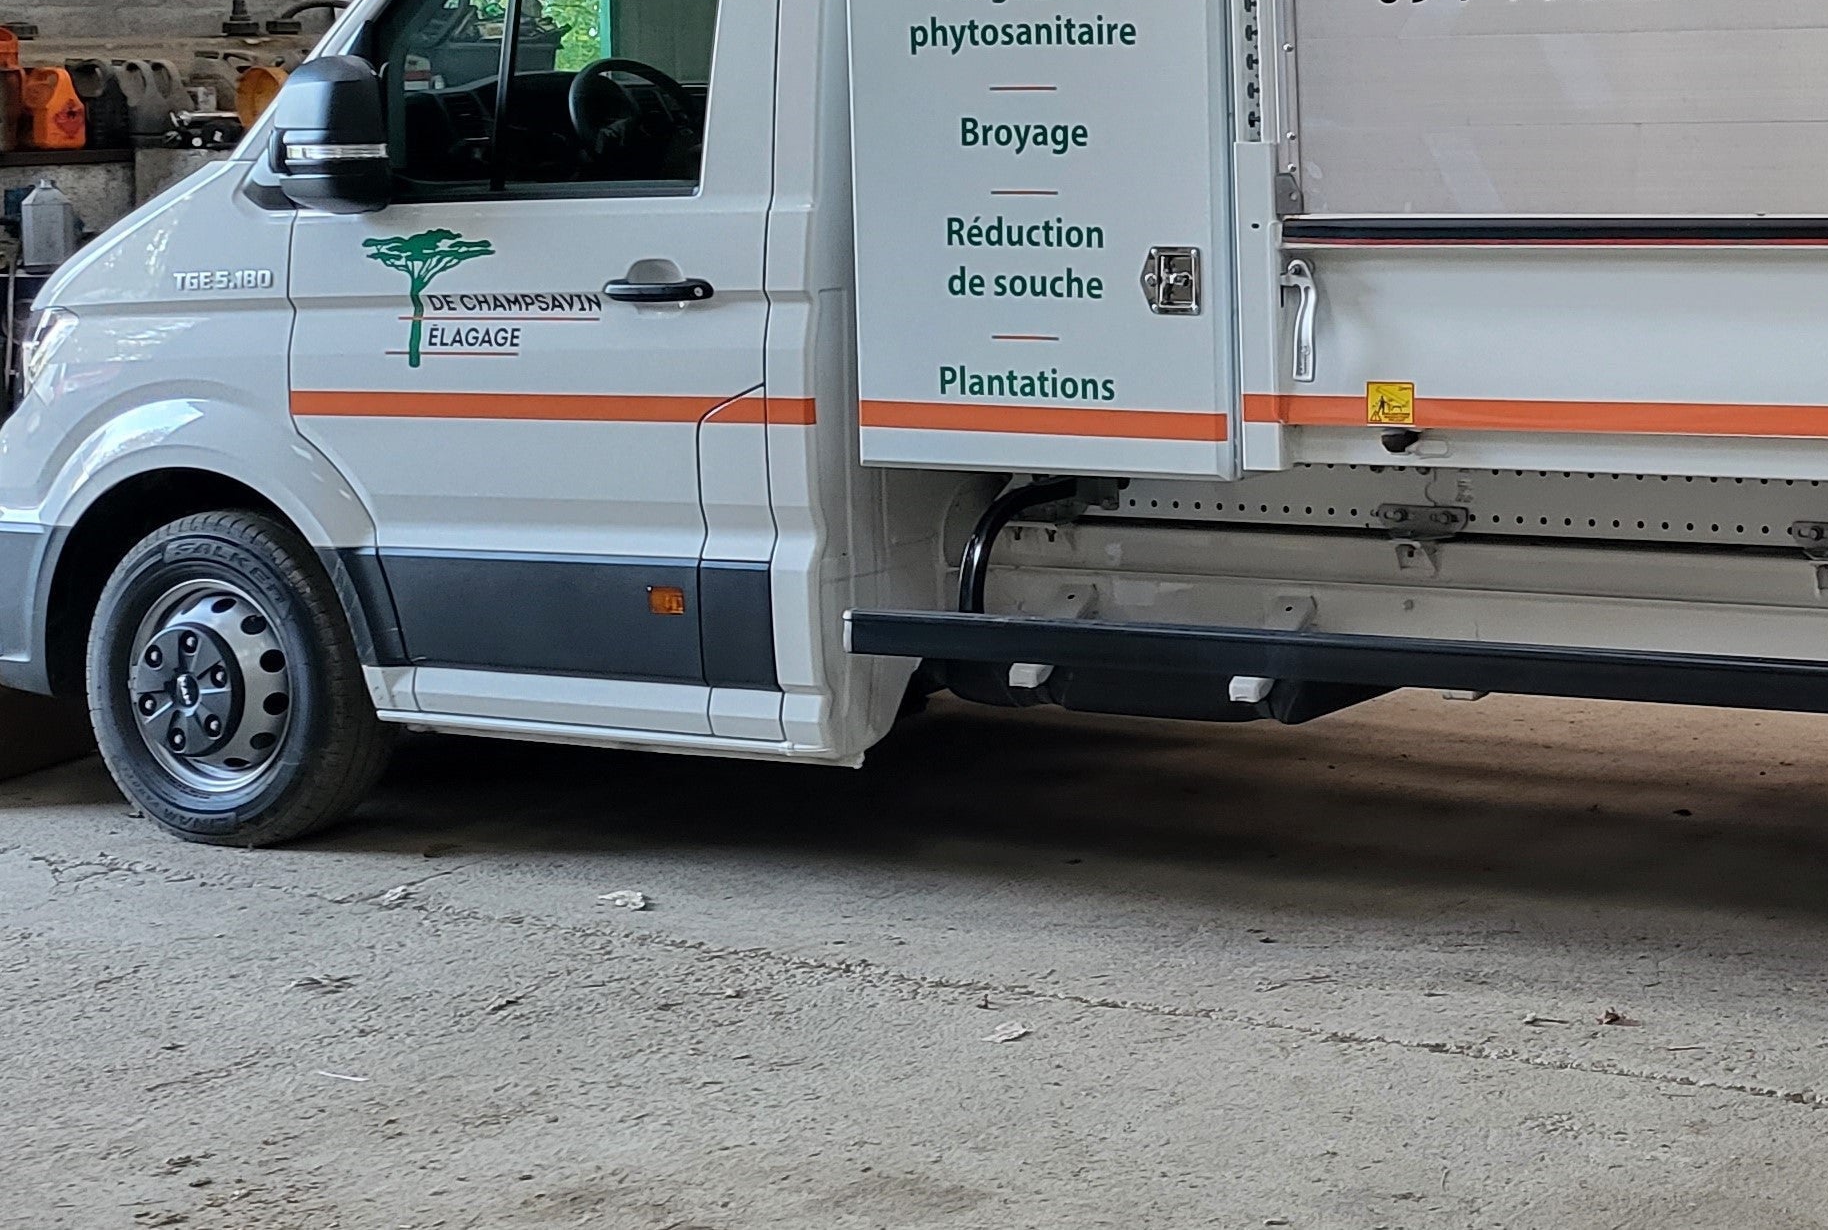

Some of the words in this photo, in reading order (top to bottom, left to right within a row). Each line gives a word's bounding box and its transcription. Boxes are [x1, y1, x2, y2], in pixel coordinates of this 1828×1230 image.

[910, 14, 1137, 56] phytosanitaire
[961, 117, 1089, 155] Broyage
[946, 215, 1104, 249] Réduction
[173, 271, 212, 291] TGE
[214, 269, 274, 290] 5.180
[947, 265, 986, 297] de
[993, 267, 1104, 300] souche
[427, 294, 458, 311] DE
[459, 293, 602, 312] CHAMPSAVIN
[938, 365, 1115, 402] Plantations
